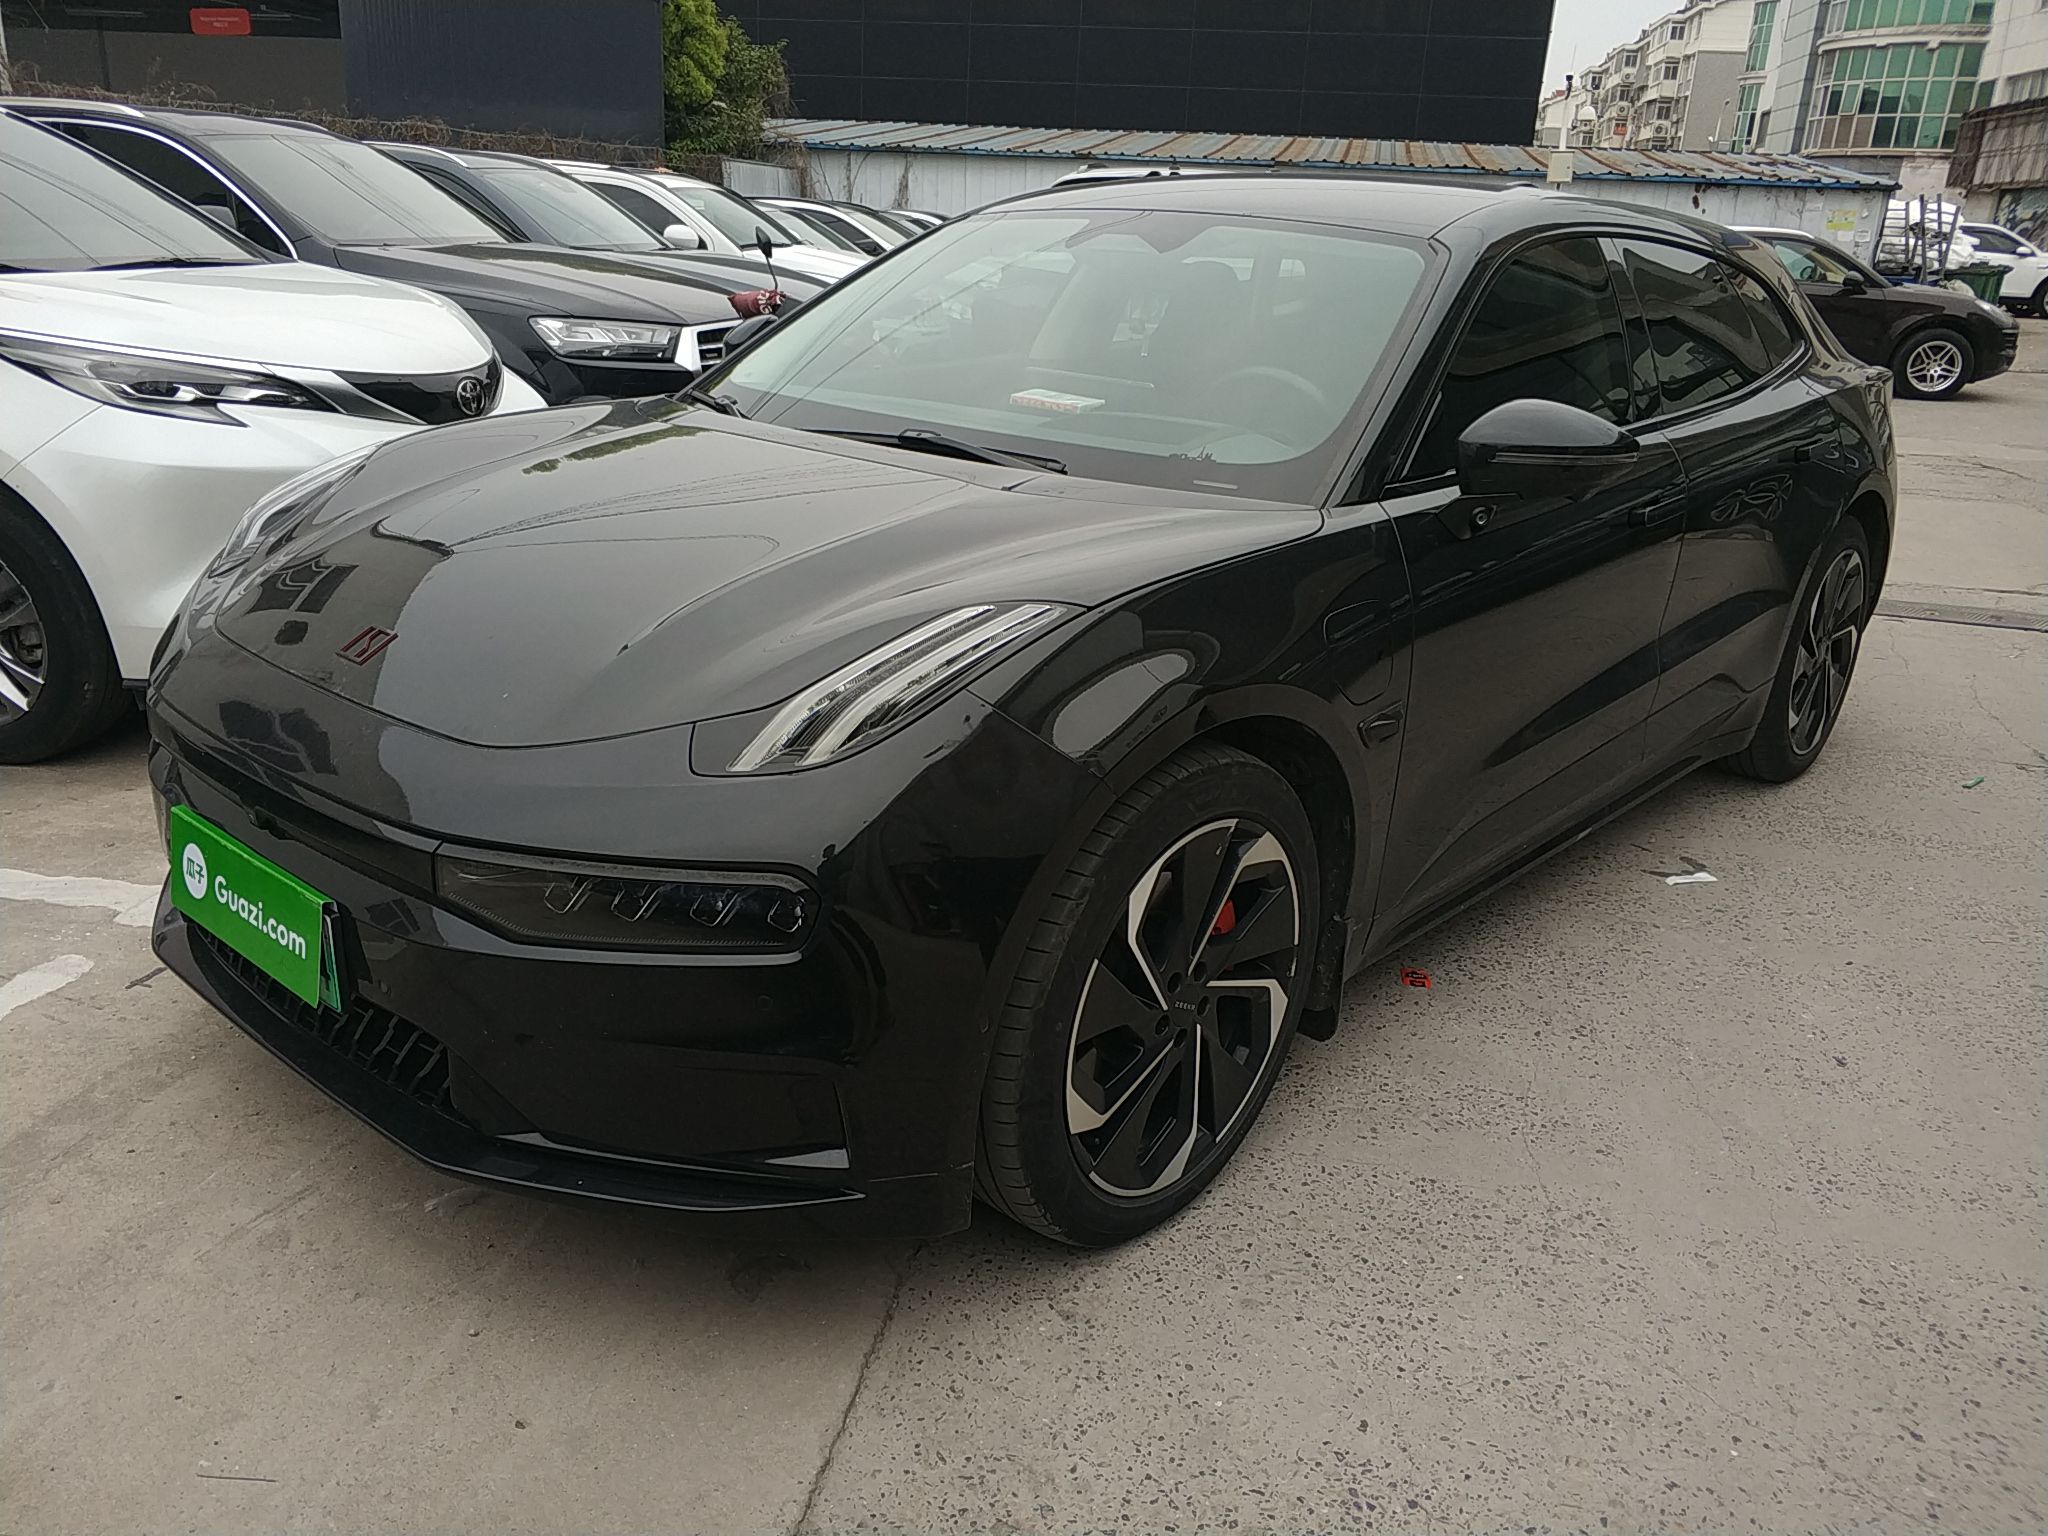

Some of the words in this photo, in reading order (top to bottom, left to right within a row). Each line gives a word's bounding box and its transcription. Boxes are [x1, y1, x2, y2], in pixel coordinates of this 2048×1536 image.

[185, 857, 205, 884] 瓜子
[214, 875, 307, 960] Guazi.com
[1174, 1001, 1196, 1011] ZEEKR
